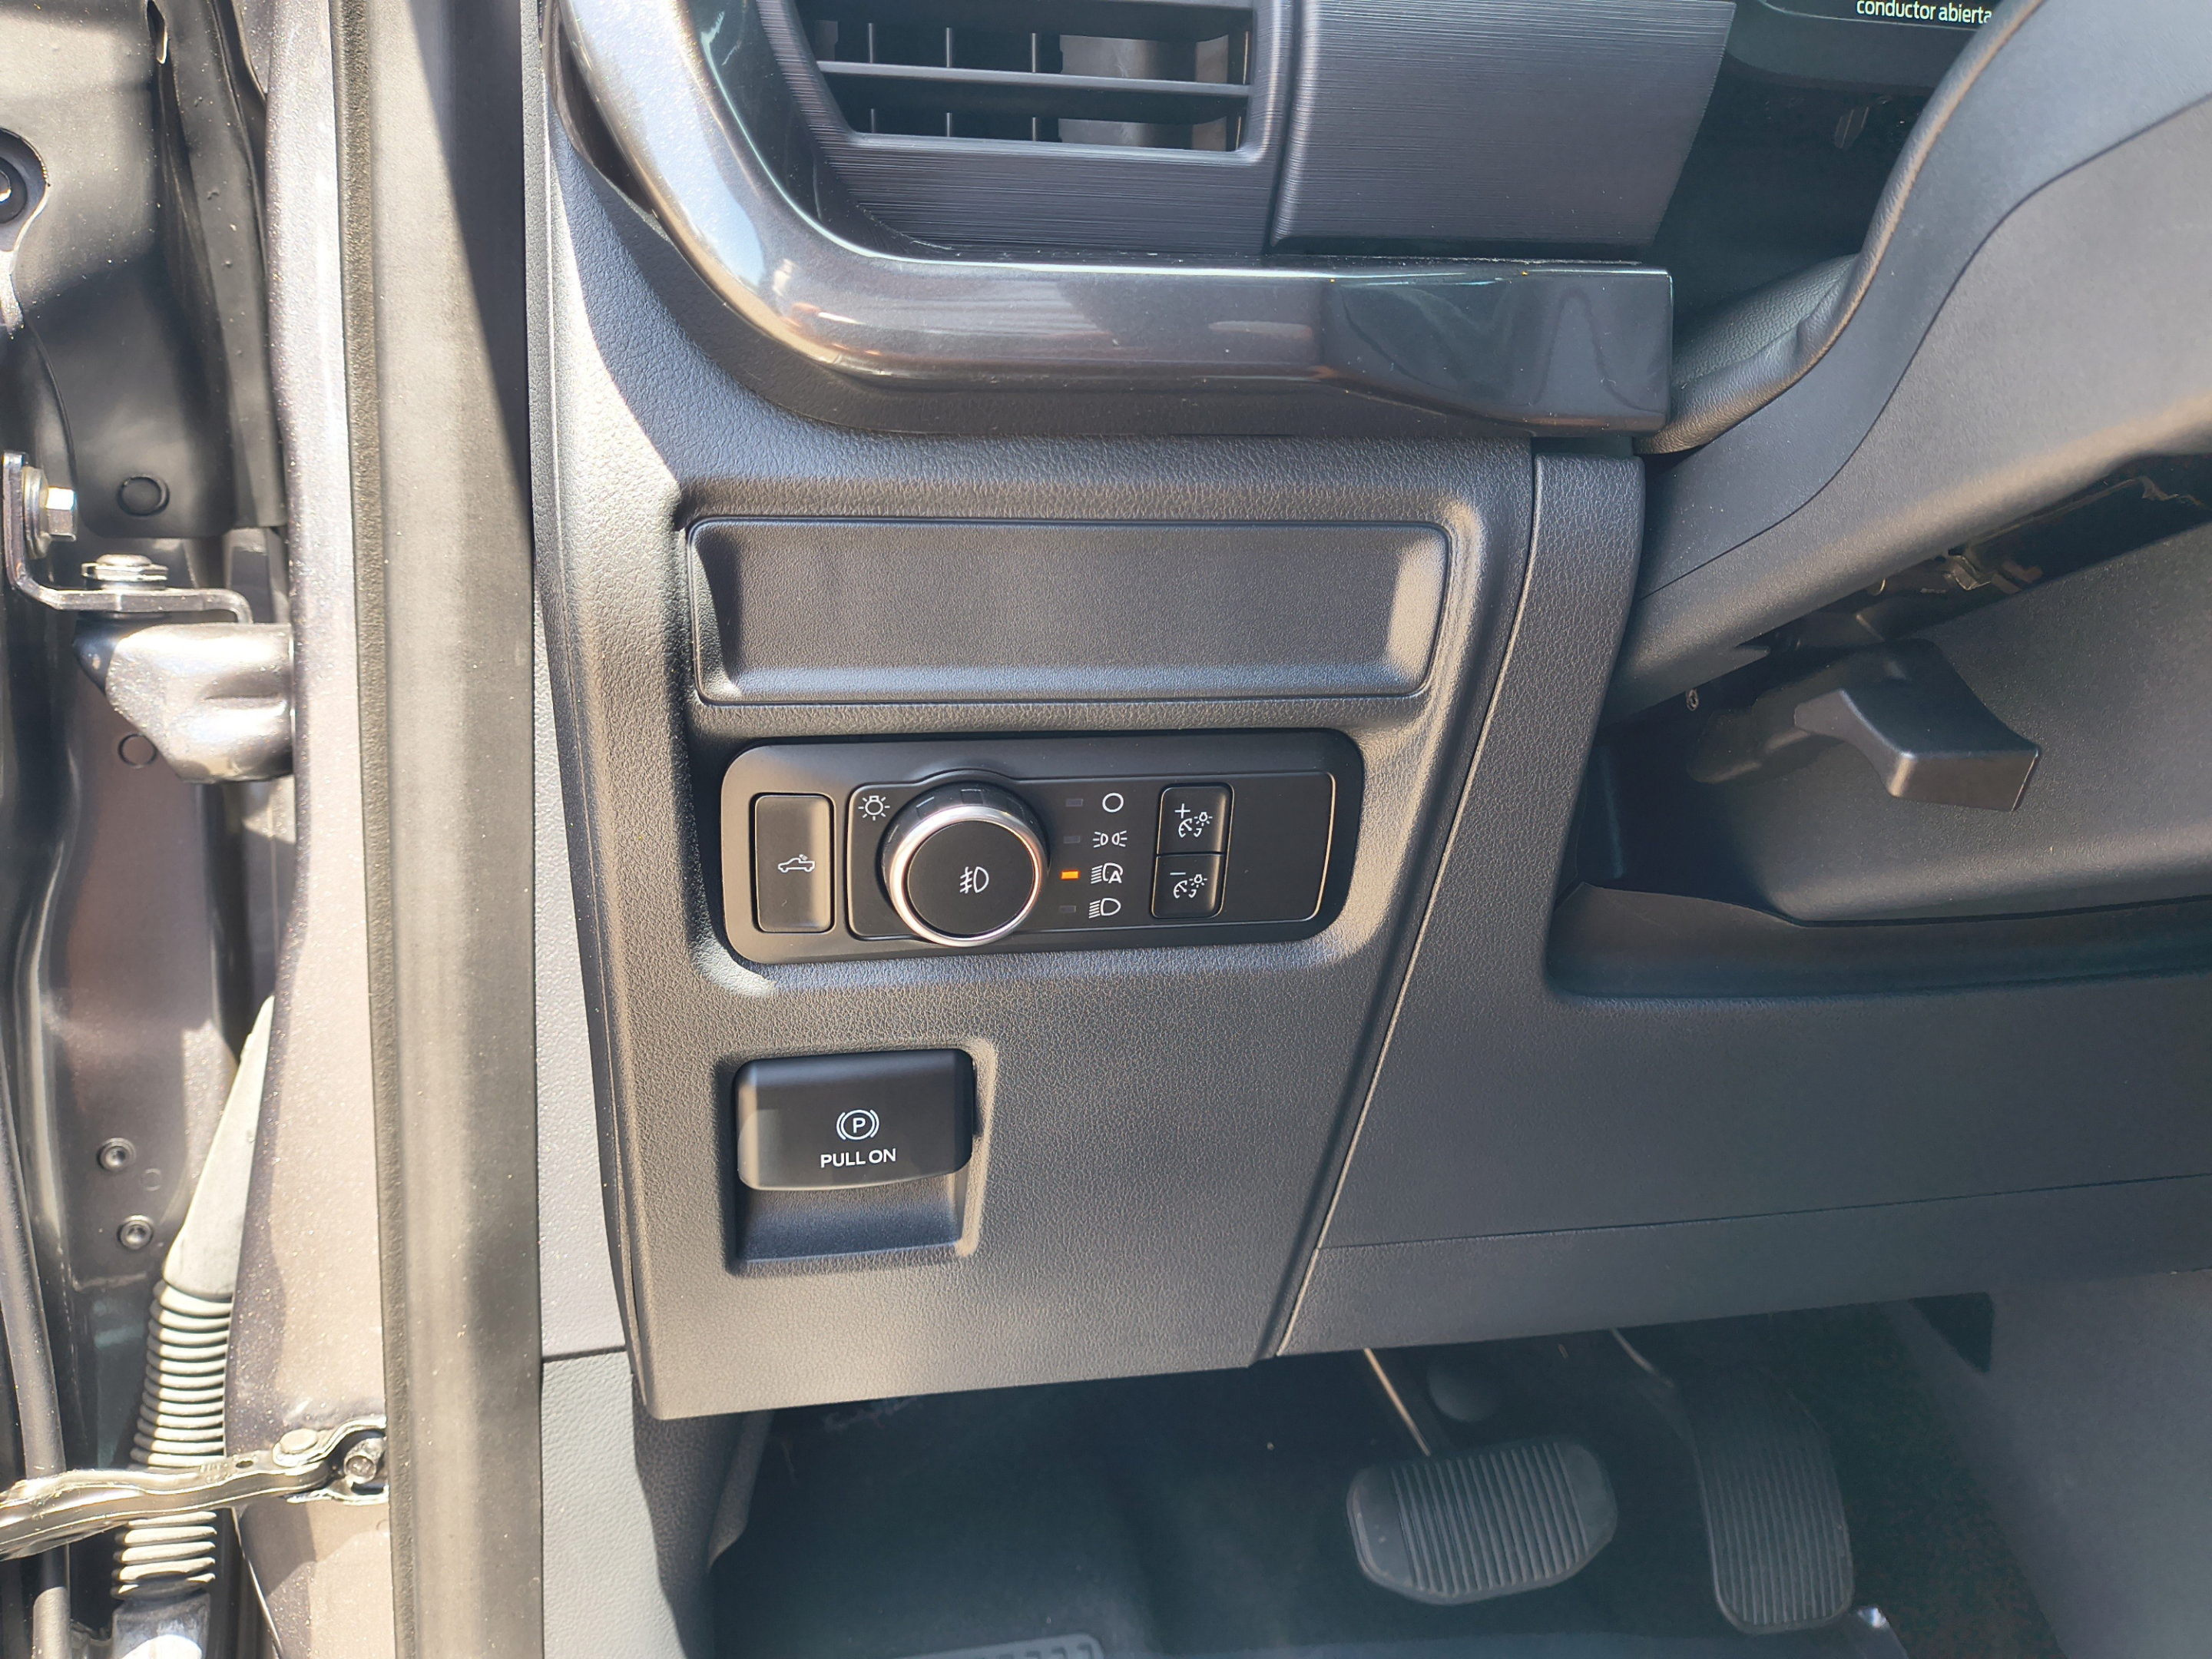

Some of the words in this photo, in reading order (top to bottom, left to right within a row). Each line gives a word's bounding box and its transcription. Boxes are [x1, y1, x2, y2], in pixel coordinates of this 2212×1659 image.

[1856, 0, 1936, 20] conductor
[1938, 2, 1992, 24] abierta
[853, 1118, 866, 1133] P
[820, 1151, 866, 1168] PULL
[869, 1148, 896, 1164] ON
